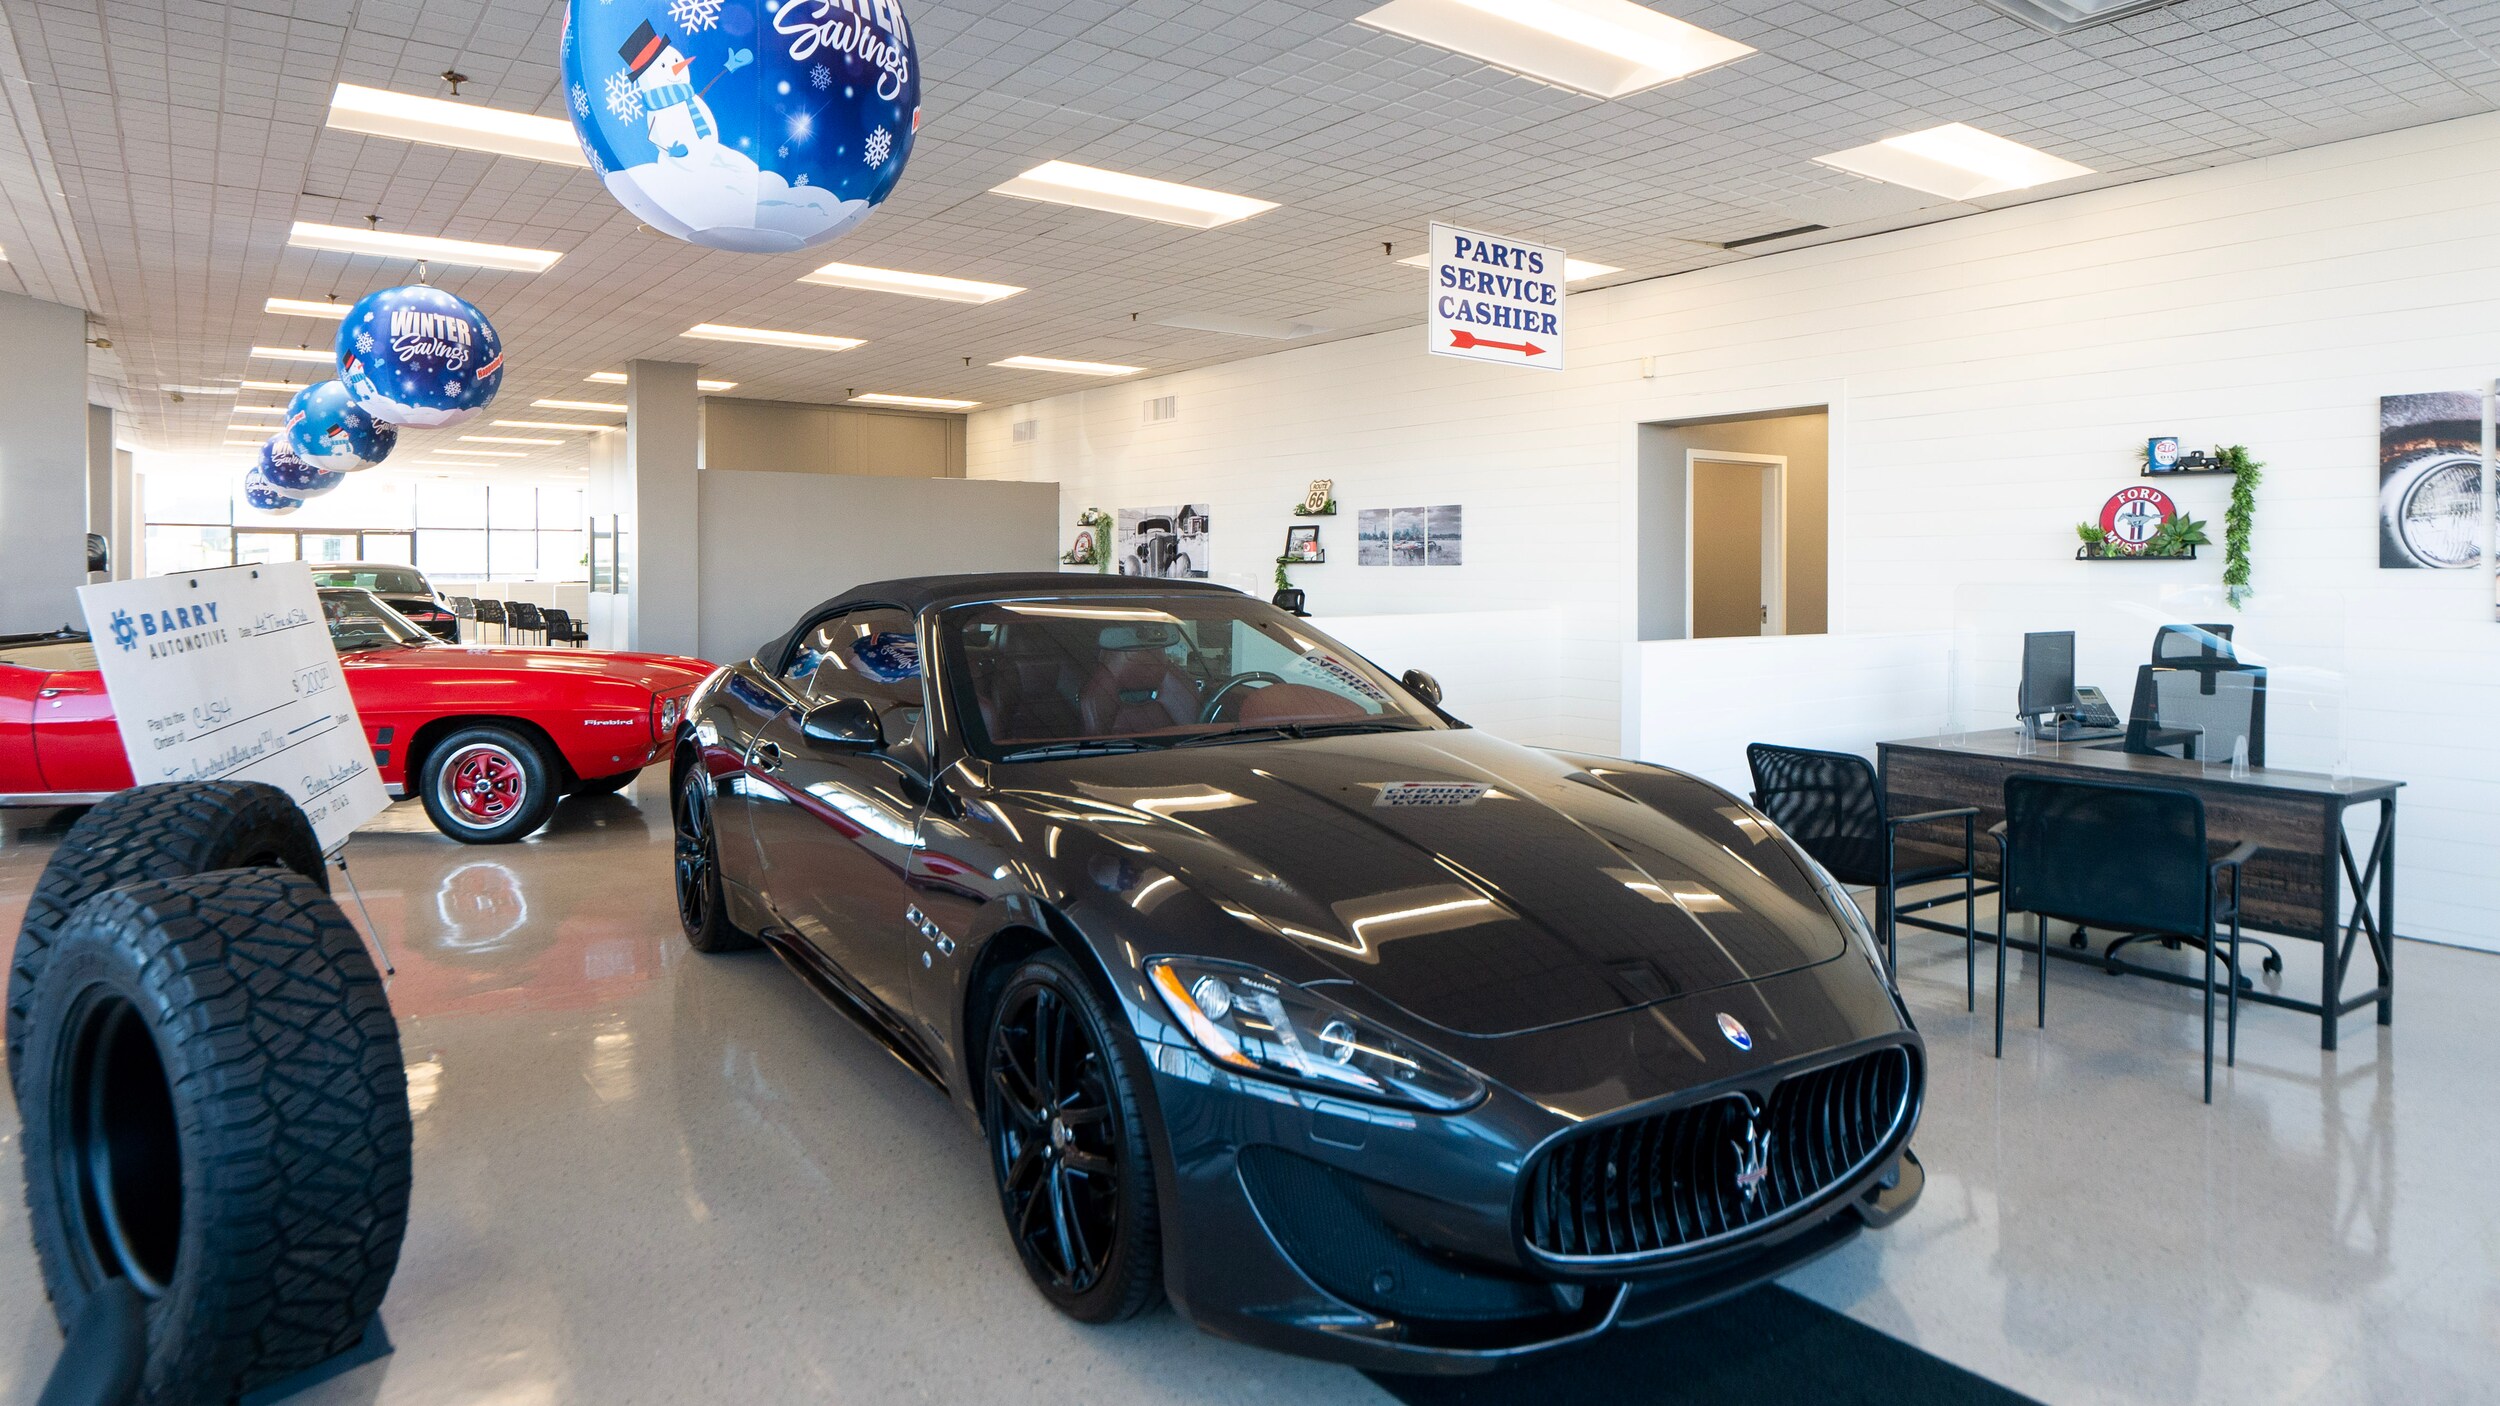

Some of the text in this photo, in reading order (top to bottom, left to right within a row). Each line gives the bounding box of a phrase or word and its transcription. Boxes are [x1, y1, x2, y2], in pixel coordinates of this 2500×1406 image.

[773, 0, 909, 101] Savings
[1454, 235, 1544, 274] PARTS
[1440, 264, 1557, 306] SERVICE
[390, 311, 471, 347] WINTER
[1438, 295, 1558, 336] CASHIER
[392, 332, 469, 371] Savings
[1308, 491, 1325, 509] 66
[2117, 488, 2162, 504] FORD
[140, 602, 219, 637] BARRY
[149, 628, 228, 660] AUTOMOTIVE
[193, 697, 232, 730] CASH
[583, 719, 634, 727] Firebird
